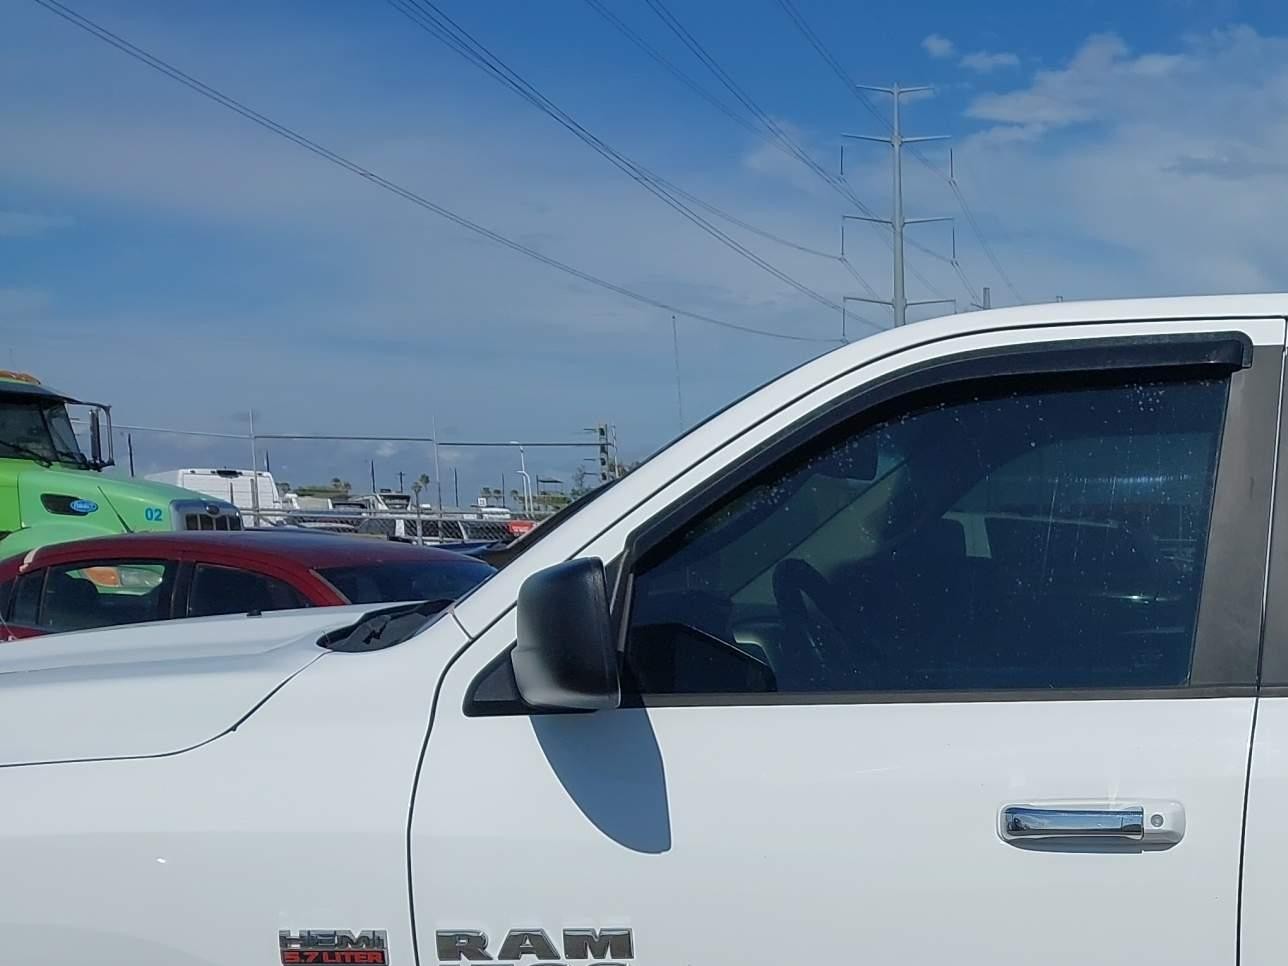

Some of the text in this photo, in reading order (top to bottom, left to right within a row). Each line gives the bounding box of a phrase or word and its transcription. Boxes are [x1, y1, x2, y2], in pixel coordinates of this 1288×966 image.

[145, 507, 162, 521] 02
[279, 930, 388, 949] HEMI
[436, 928, 634, 961] RAM
[284, 951, 384, 964] 5.7 LITER
